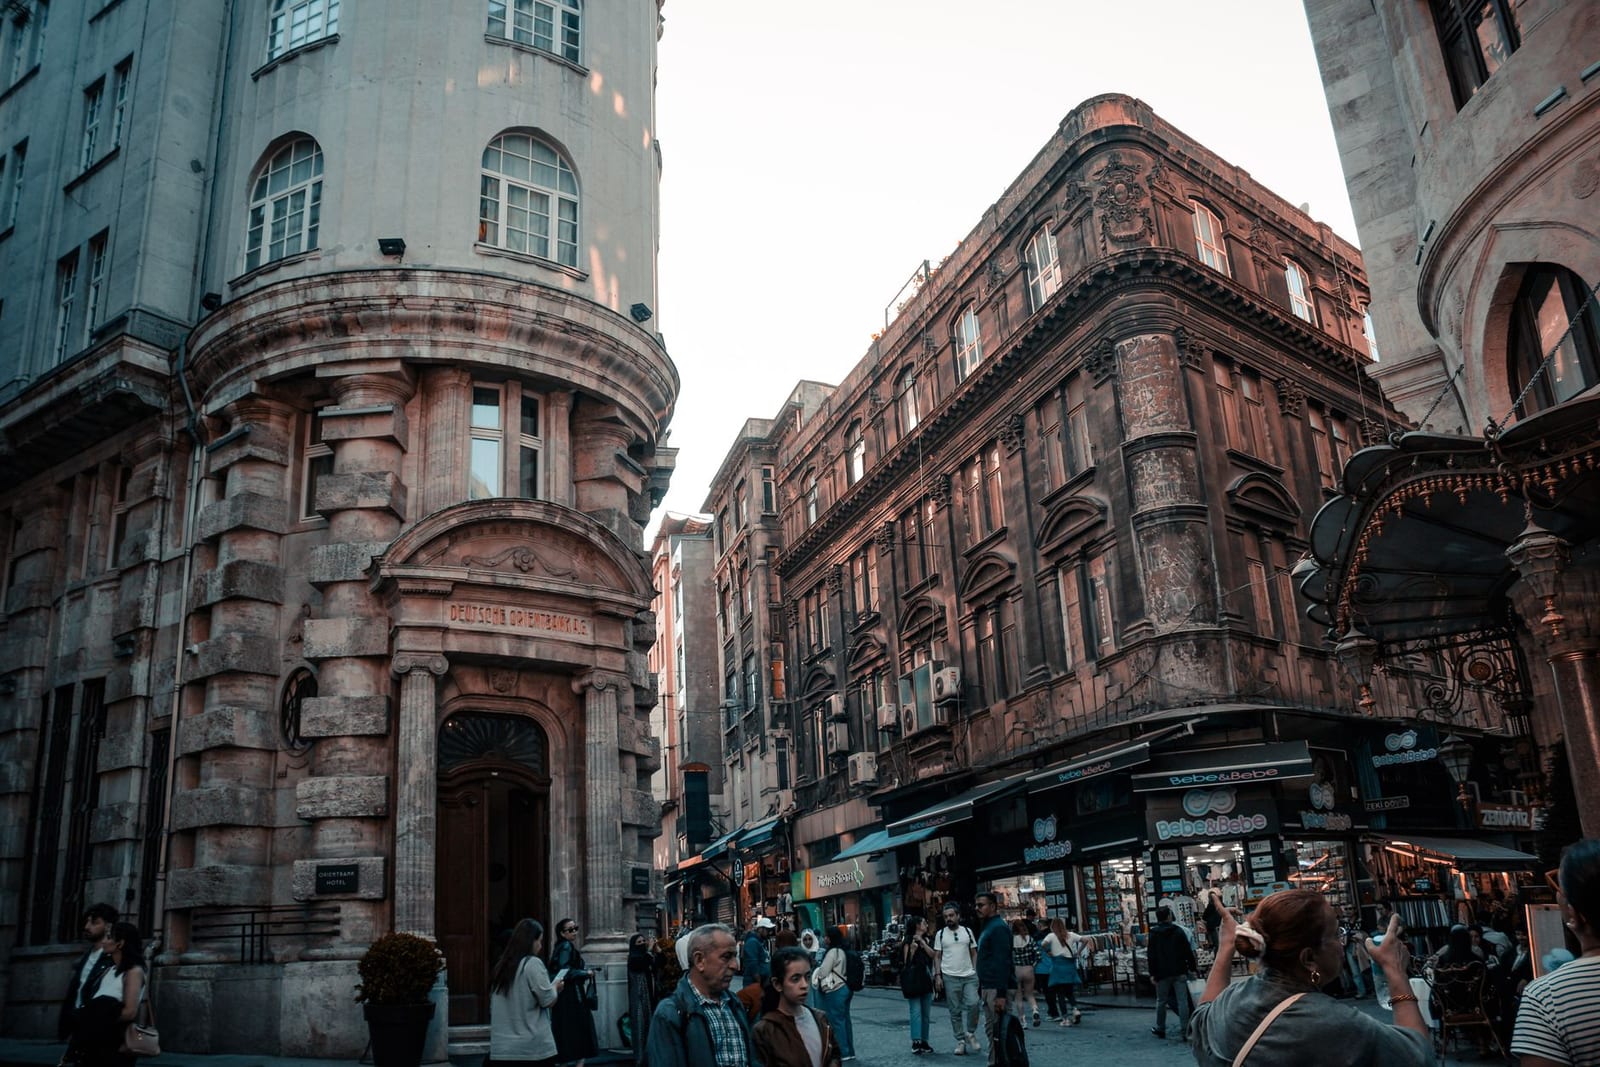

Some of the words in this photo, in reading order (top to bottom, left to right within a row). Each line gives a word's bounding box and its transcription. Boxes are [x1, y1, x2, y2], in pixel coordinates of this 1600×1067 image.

[450, 604, 506, 625] DEUTSCHE
[509, 610, 571, 632] ORIENTBANK
[1372, 748, 1437, 768] Bebe&Bebe
[1058, 761, 1112, 782] Bebe&Bebe
[1168, 768, 1279, 786] Bebe&Bebe
[1155, 813, 1267, 841] Bebe&Bebe
[1023, 840, 1072, 864] Bebe&Bebe
